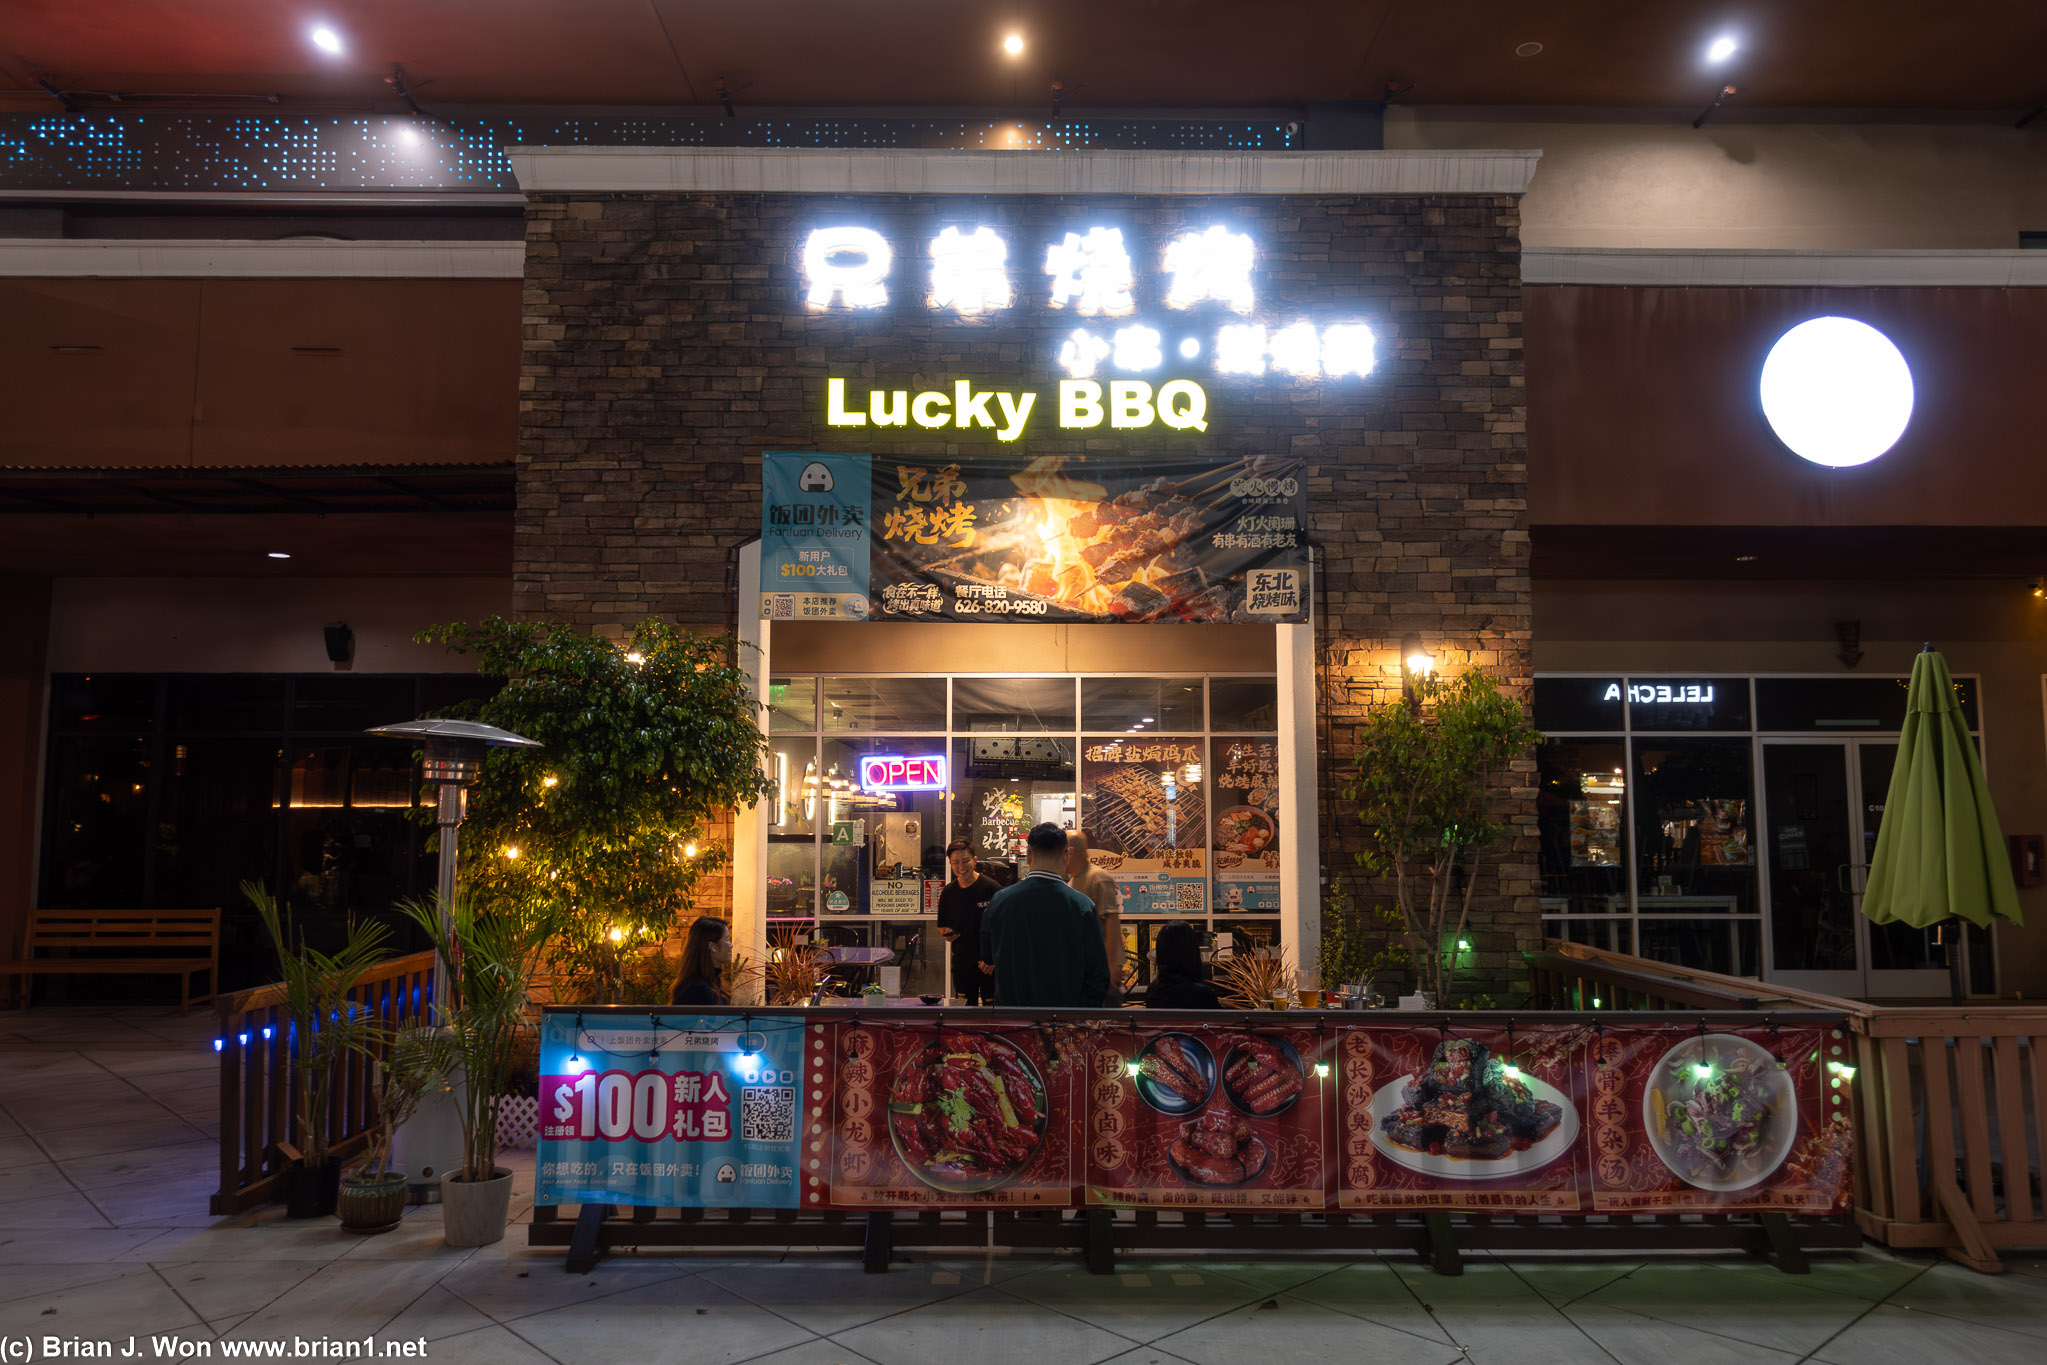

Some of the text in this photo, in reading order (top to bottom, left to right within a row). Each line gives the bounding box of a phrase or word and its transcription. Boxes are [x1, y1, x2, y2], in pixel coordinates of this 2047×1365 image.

[827, 378, 1208, 441] Lucky BBQ
[896, 464, 967, 506] 兄弟
[769, 504, 864, 526] 饭团外卖
[884, 501, 976, 548] 烧烤
[1237, 516, 1297, 532] 灯火阑珊
[769, 527, 863, 541] Fantuan Delivery
[1212, 533, 1298, 549] 有串有酒有老友
[799, 551, 831, 562] 新用户
[955, 585, 1007, 599] 餐厅电话
[1251, 572, 1294, 592] 东北
[955, 600, 1048, 615] 626-820-9580
[1249, 591, 1297, 611] 烧烤味
[866, 760, 941, 787] OPEN
[836, 827, 850, 841] A
[888, 881, 903, 889] NO
[685, 1036, 719, 1046] 兄弟烧烤
[674, 1075, 727, 1103] 新人
[554, 1074, 667, 1138] $100
[844, 1033, 870, 1174] 麻辣小龙虾
[1096, 1054, 1122, 1164] 招牌卤味
[1346, 1034, 1371, 1184] 老长沙臭豆腐
[673, 1110, 728, 1138] 礼包
[740, 1164, 792, 1179] 饭团外卖
